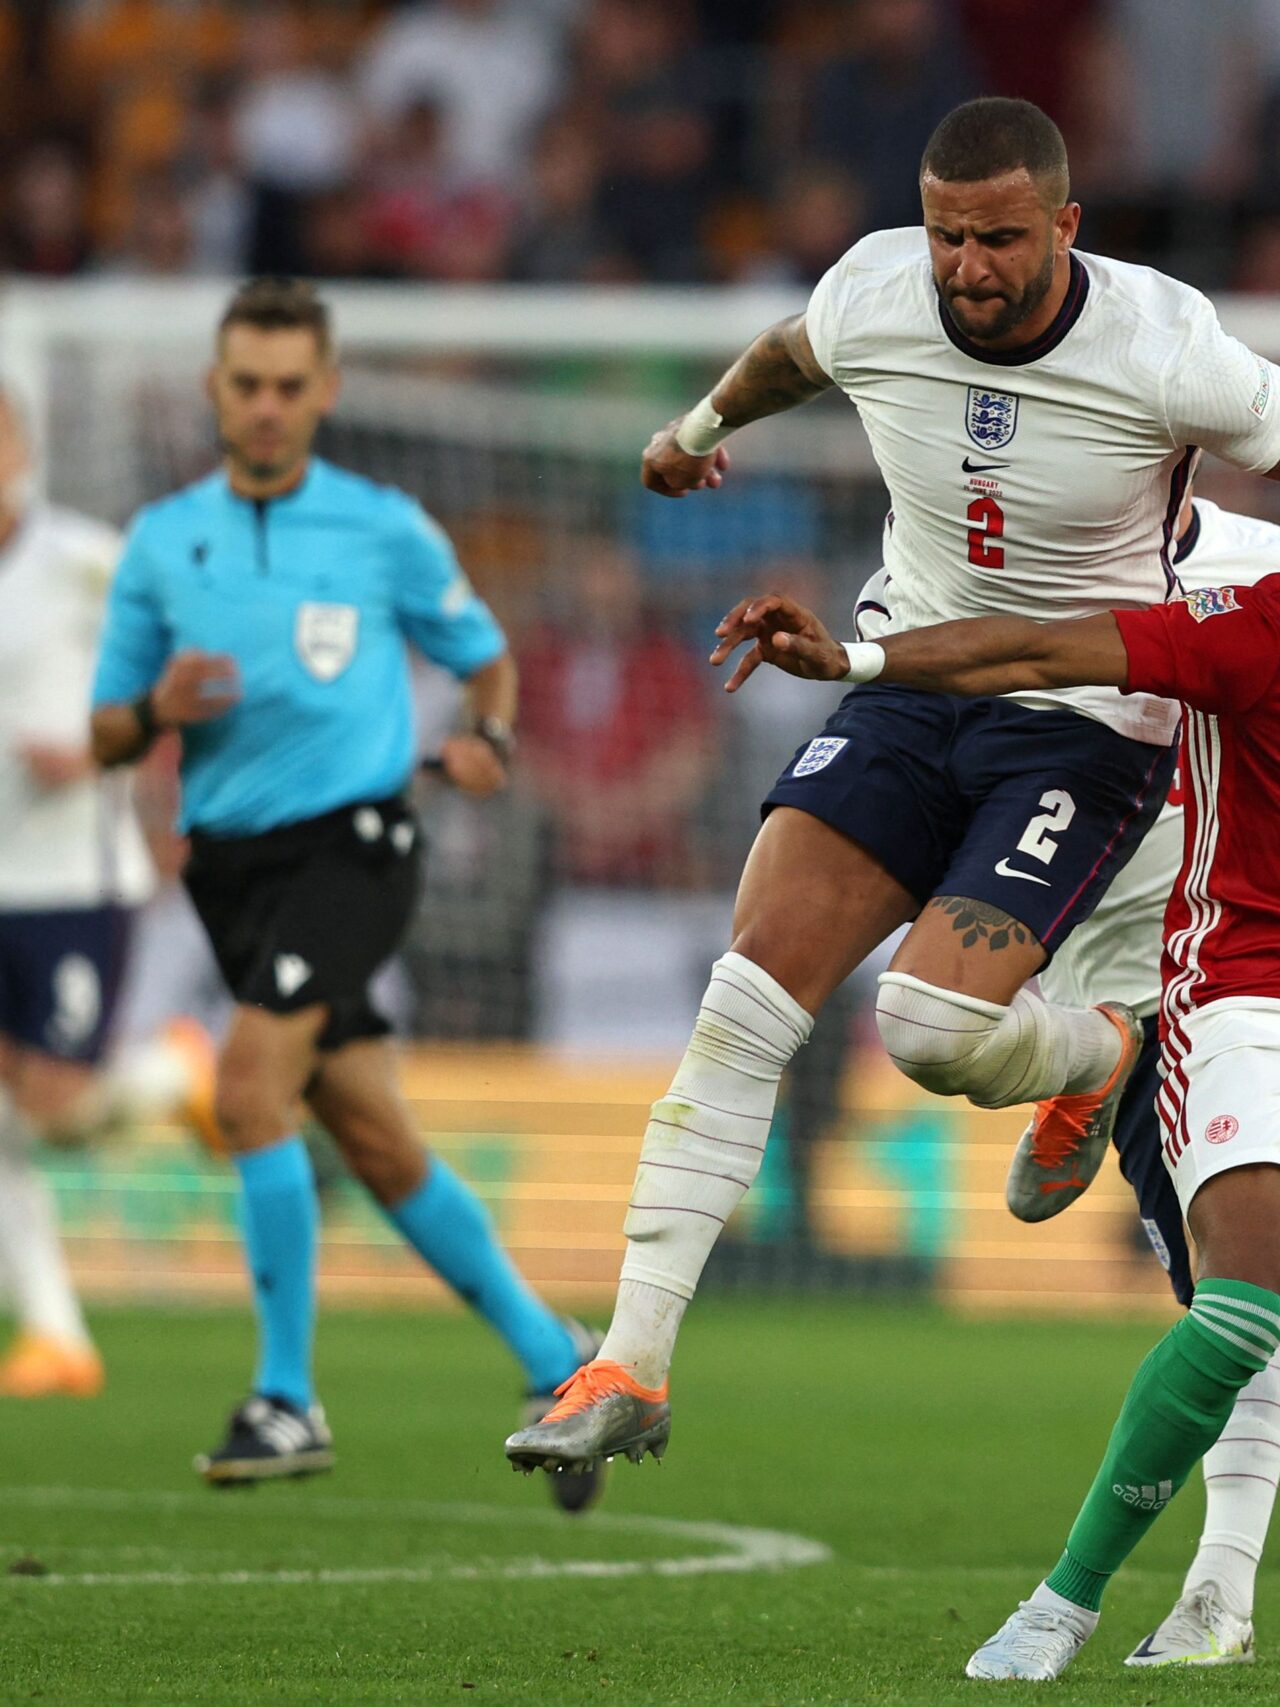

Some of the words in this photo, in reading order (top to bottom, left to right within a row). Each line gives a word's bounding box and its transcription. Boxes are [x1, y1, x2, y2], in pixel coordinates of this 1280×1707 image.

[970, 479, 999, 489] HUNGARY
[967, 496, 1005, 569] 2
[1016, 789, 1076, 866] 2
[1112, 1484, 1166, 1509] adida
